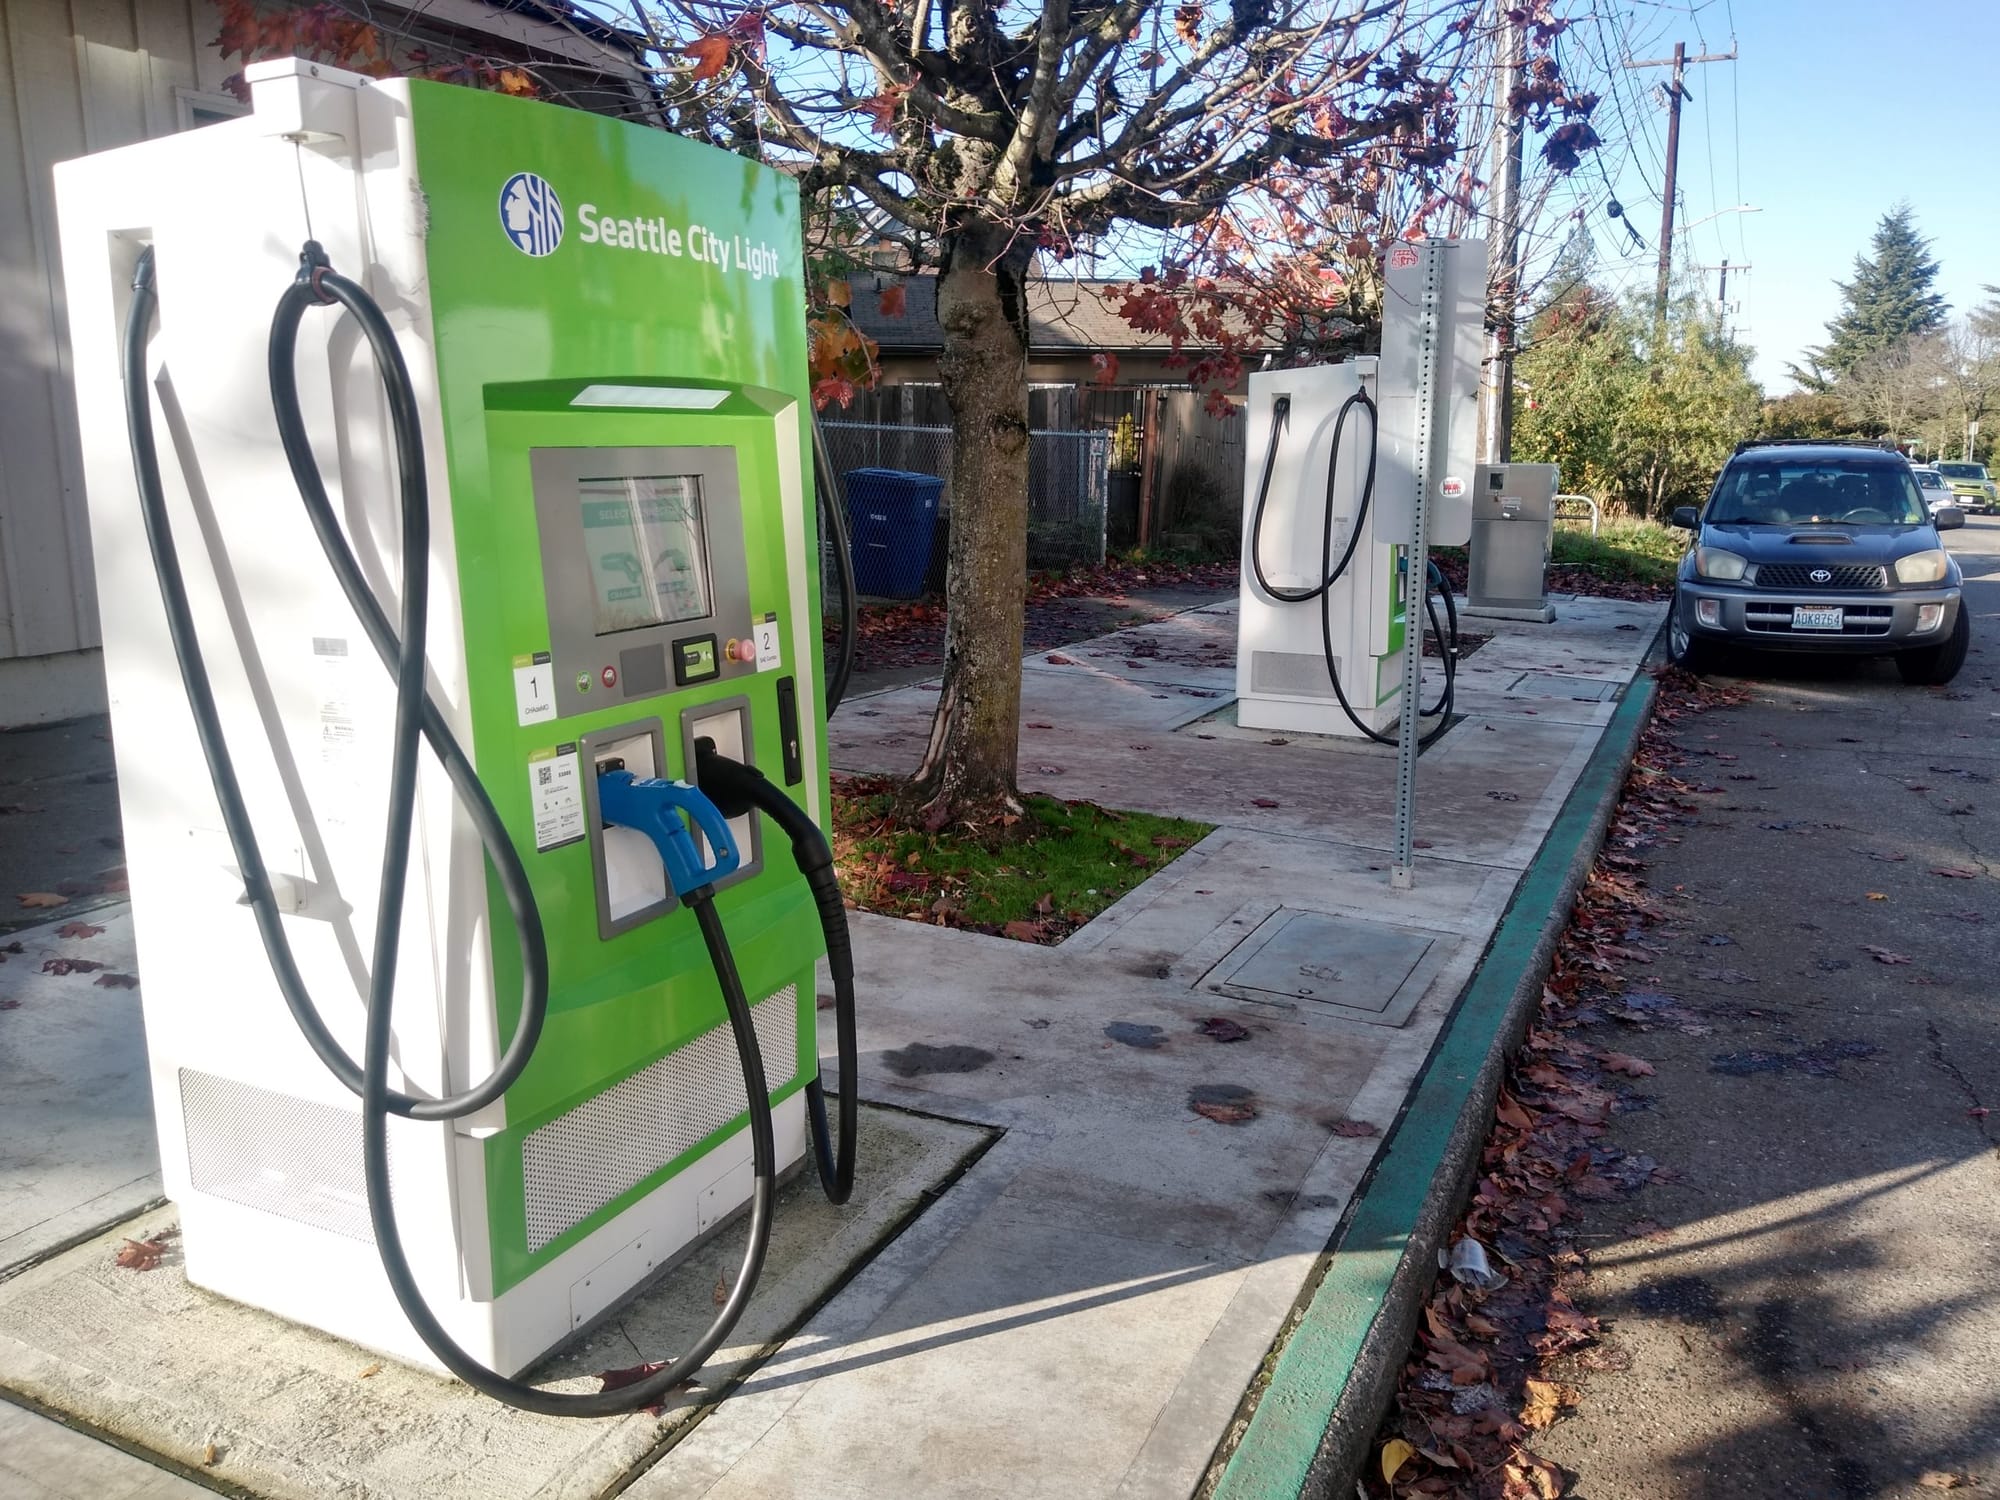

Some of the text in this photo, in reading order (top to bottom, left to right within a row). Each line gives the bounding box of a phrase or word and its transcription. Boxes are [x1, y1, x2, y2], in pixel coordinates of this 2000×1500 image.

[578, 203, 779, 281] Seattle City Light
[763, 632, 771, 650] 2
[530, 676, 538, 698] 1
